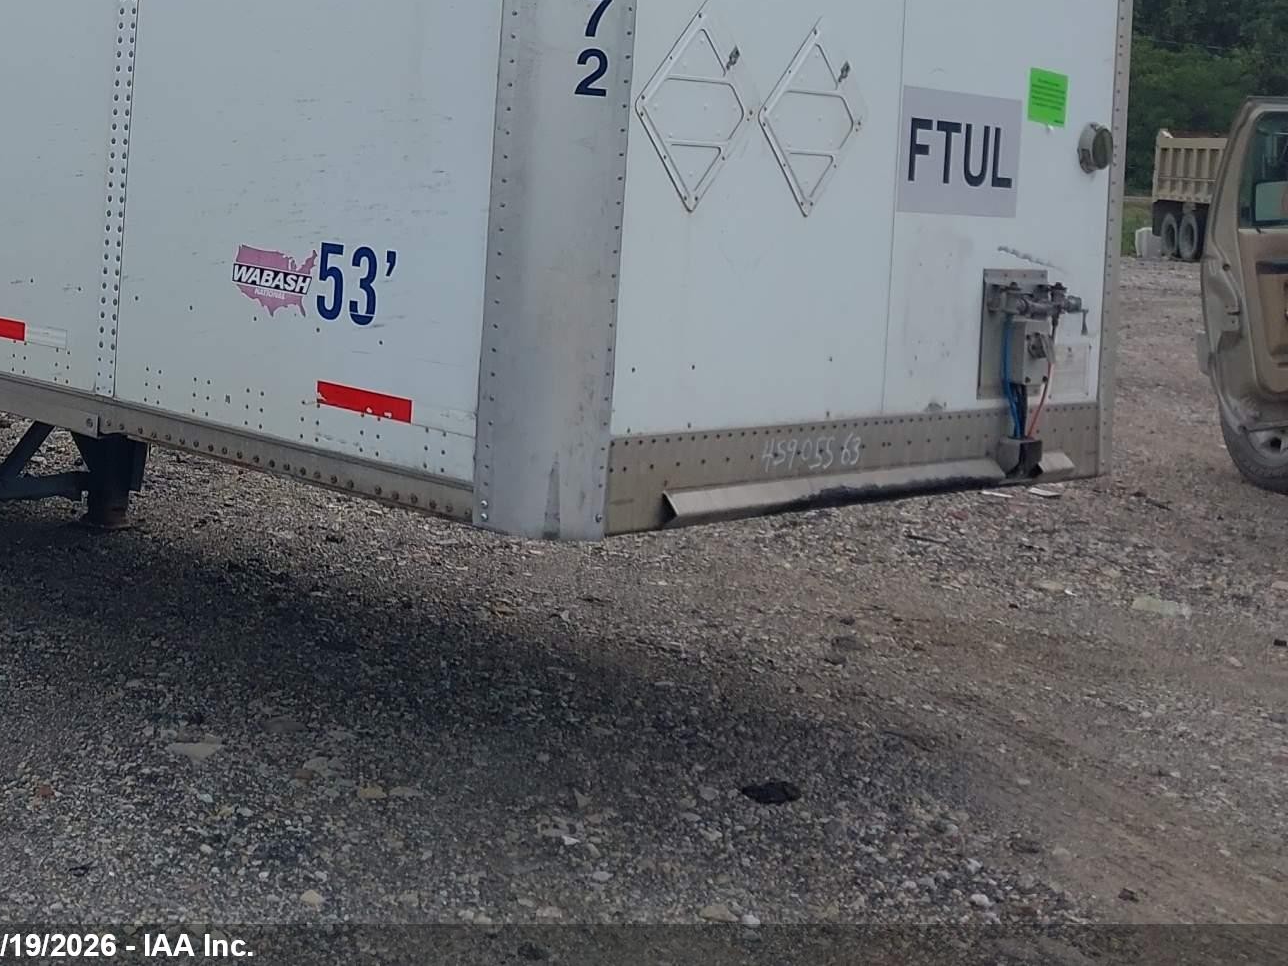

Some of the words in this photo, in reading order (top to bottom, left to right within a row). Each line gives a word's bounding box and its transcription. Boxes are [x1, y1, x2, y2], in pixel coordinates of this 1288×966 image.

[908, 117, 1012, 189] FTUL
[232, 264, 312, 294] WABASH
[254, 287, 286, 300] NATIONAL
